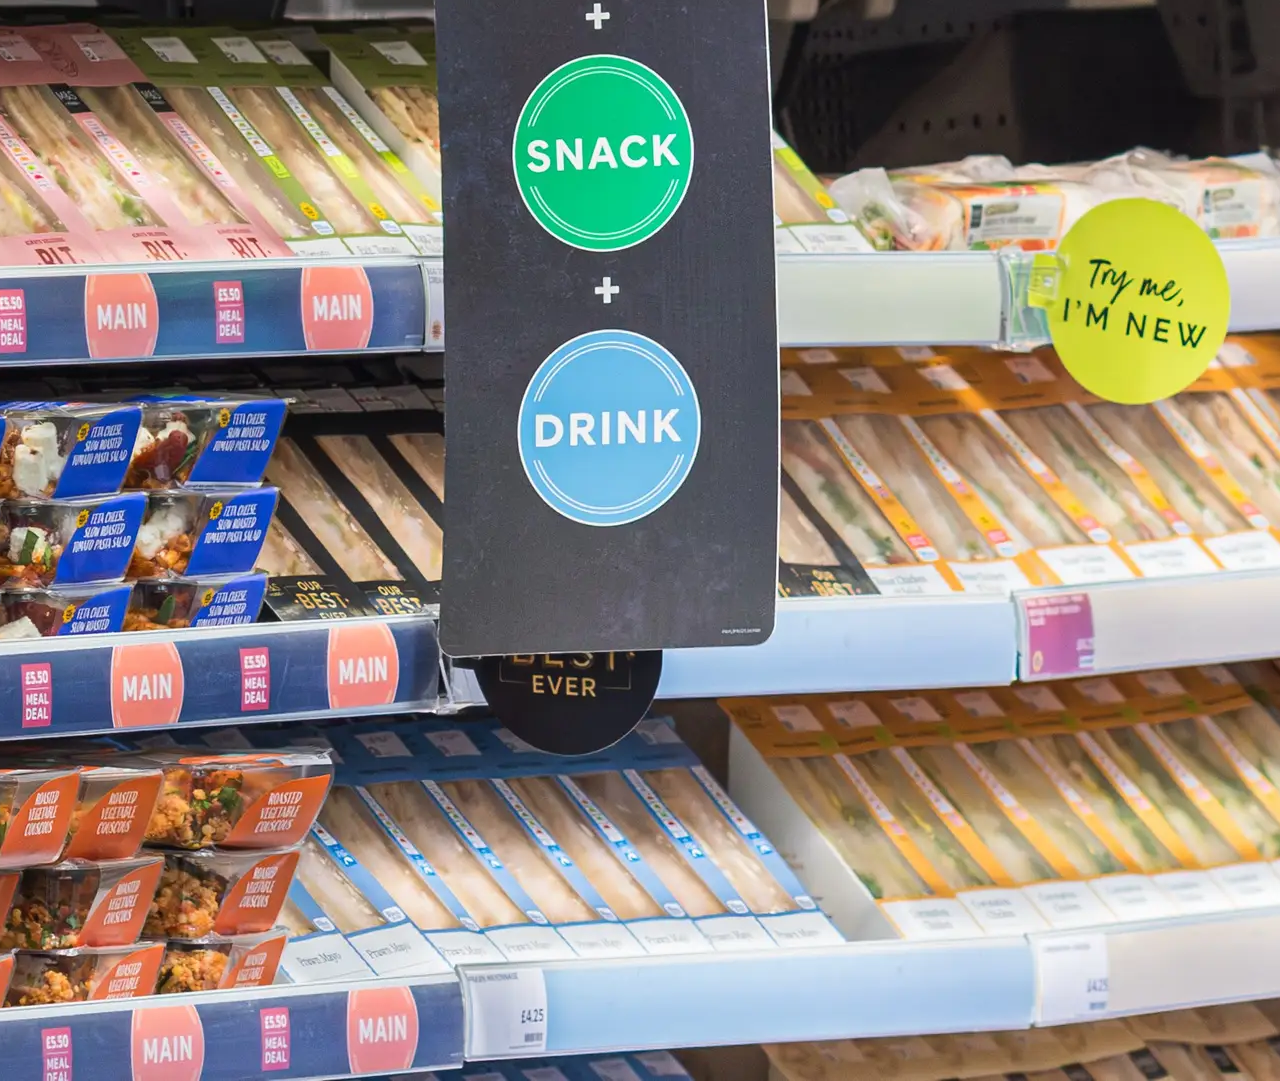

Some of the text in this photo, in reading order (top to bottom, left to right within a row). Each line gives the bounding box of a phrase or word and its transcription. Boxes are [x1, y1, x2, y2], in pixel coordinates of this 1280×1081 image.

[526, 133, 679, 174] SNACK
[1089, 259, 1184, 307] Try me,
[218, 288, 241, 302] £5.50
[0, 297, 22, 310] £5.50
[313, 294, 361, 321] MAIN
[97, 303, 147, 330] MAIN
[220, 309, 242, 322] MEAL
[0, 318, 23, 331] MEAL
[220, 323, 242, 337] DEAL
[1063, 298, 1206, 348] I'M NEW
[0, 332, 24, 346] DEAL
[535, 408, 681, 448] DRINK
[297, 581, 323, 591] OUR
[378, 586, 403, 595] OUR
[298, 592, 346, 609] BEST
[376, 597, 422, 615] BEST
[243, 655, 267, 669] £5.50
[25, 670, 49, 686] £5.50
[339, 657, 387, 685] MAIN
[123, 674, 172, 702] MAIN
[245, 677, 267, 689] MEAL
[532, 675, 596, 697] EVER
[26, 693, 49, 706] MEAL
[244, 690, 267, 704] DEAL
[26, 707, 48, 721] DEAL
[268, 791, 302, 805] ROASTED
[260, 805, 301, 819] VEGETABLE
[255, 819, 292, 833] COUSCOUS
[264, 1015, 287, 1030] £5.50
[521, 1009, 544, 1024] £4.25
[359, 1015, 407, 1042] MAIN
[265, 1036, 288, 1050] MEAL
[143, 1036, 193, 1065] MAIN
[265, 1051, 288, 1064] DEAL
